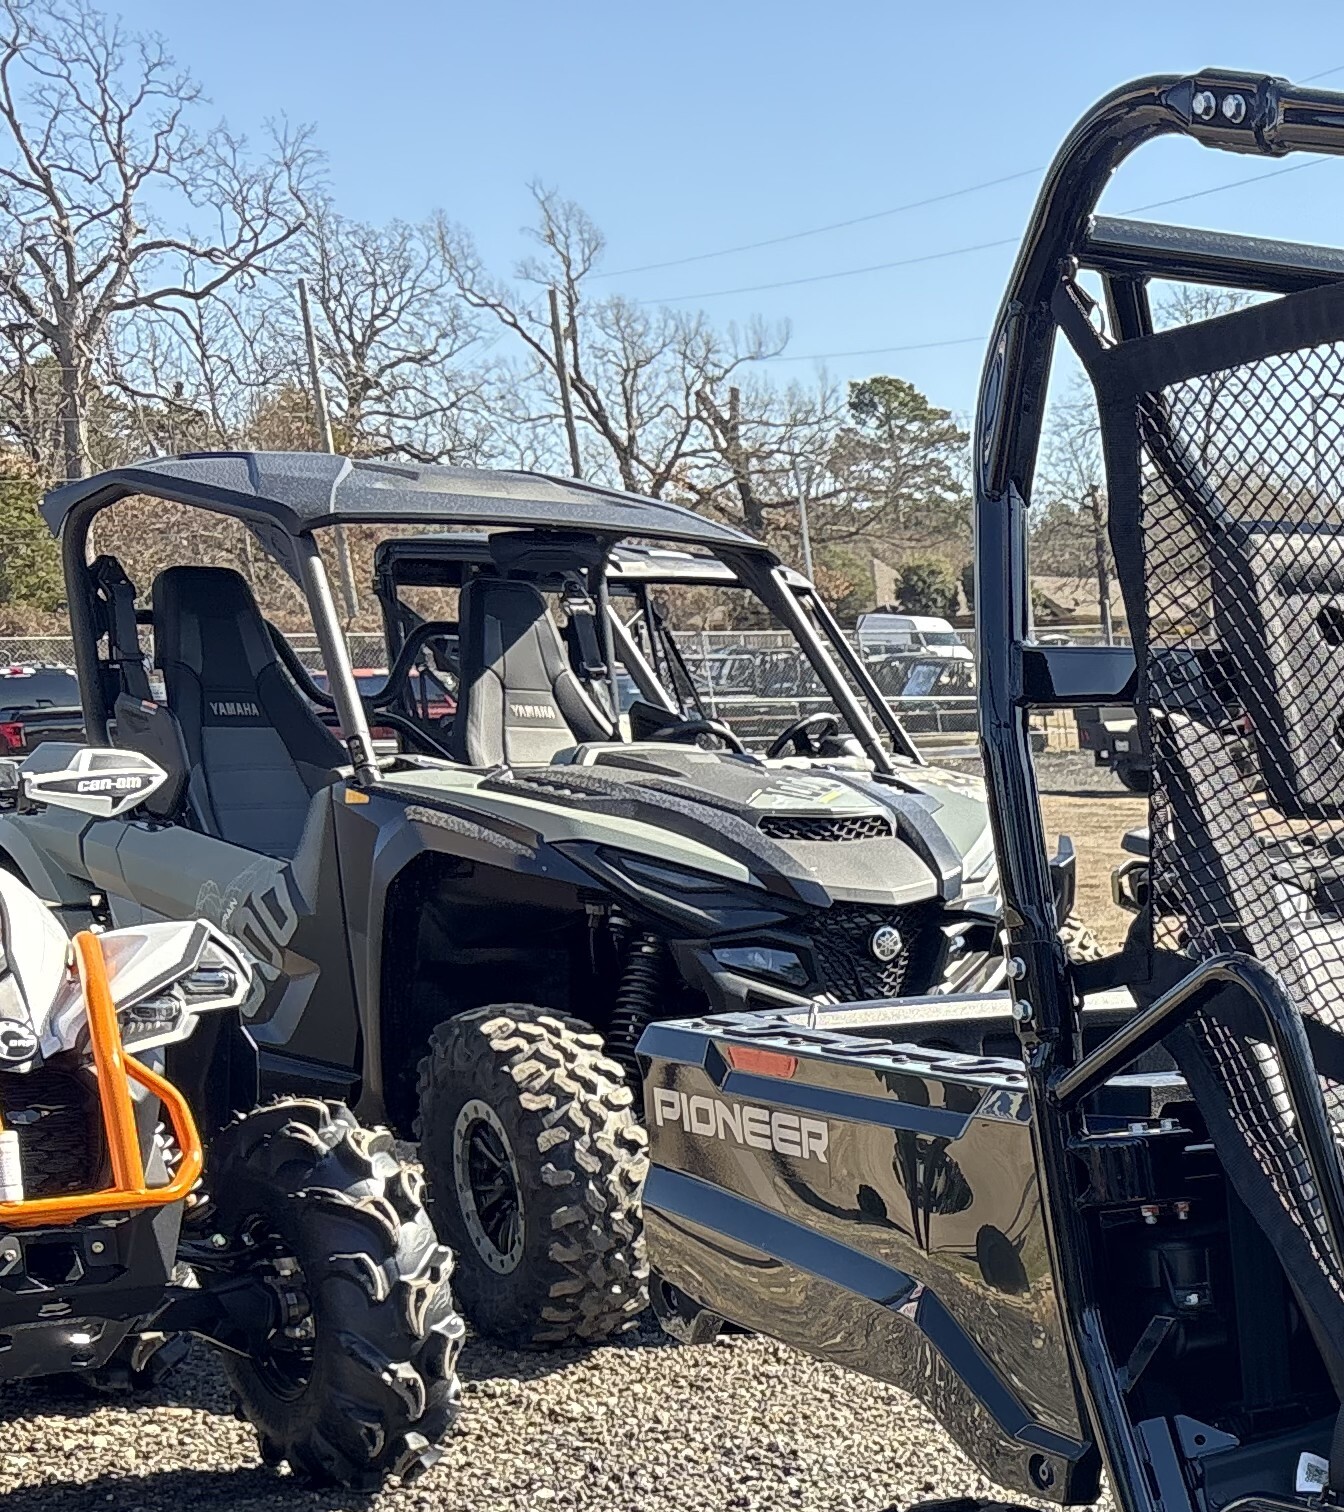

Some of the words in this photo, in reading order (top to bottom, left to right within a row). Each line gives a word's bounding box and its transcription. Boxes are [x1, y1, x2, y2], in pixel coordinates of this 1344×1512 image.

[209, 701, 260, 717] YAMAHA
[510, 704, 556, 720] YAMAHA
[78, 776, 142, 792] can-am
[653, 1087, 829, 1164] PIONEER
